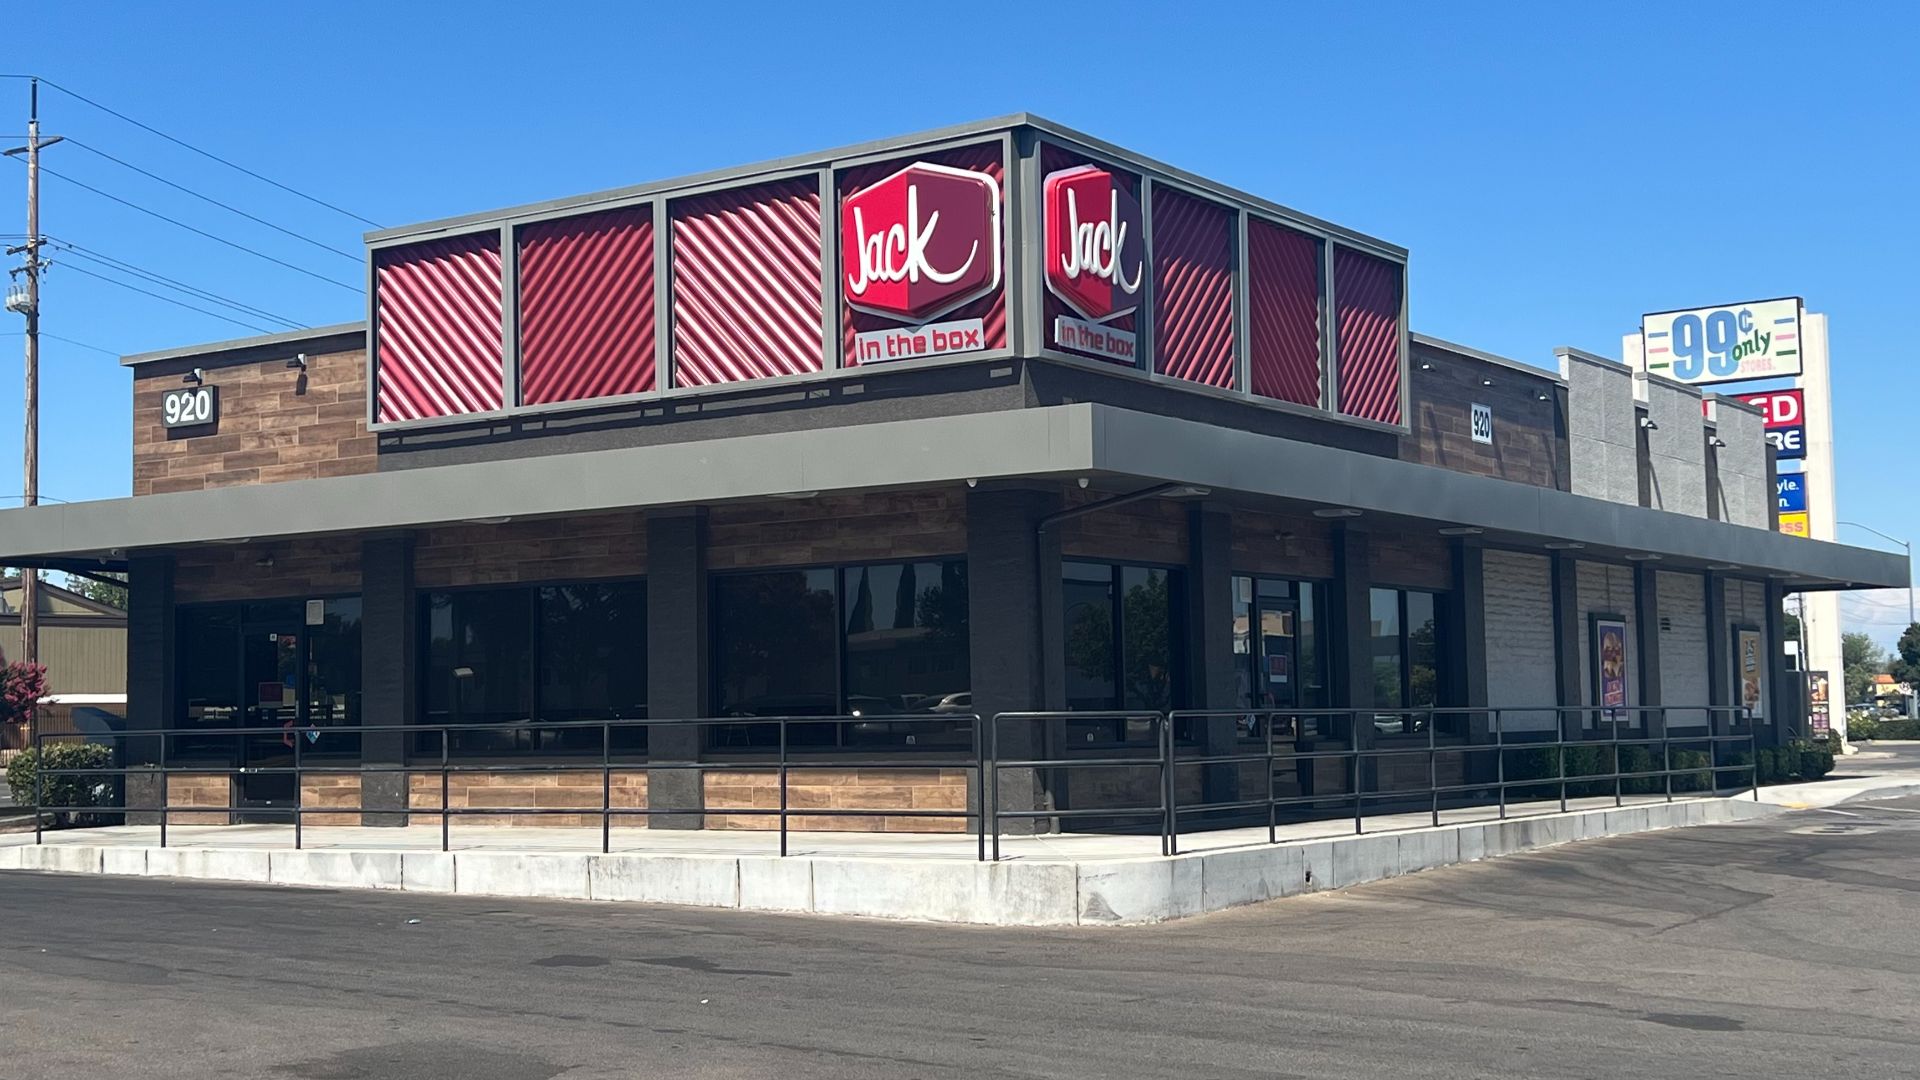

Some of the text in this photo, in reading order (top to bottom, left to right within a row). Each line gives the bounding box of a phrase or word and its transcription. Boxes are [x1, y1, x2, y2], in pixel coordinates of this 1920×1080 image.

[848, 185, 979, 295] Jack
[1061, 188, 1143, 295] Jack
[859, 329, 979, 361] in the box
[1061, 320, 1134, 358] in the box
[1732, 329, 1771, 362] only
[165, 390, 211, 424] 920
[1474, 409, 1490, 438] 920
